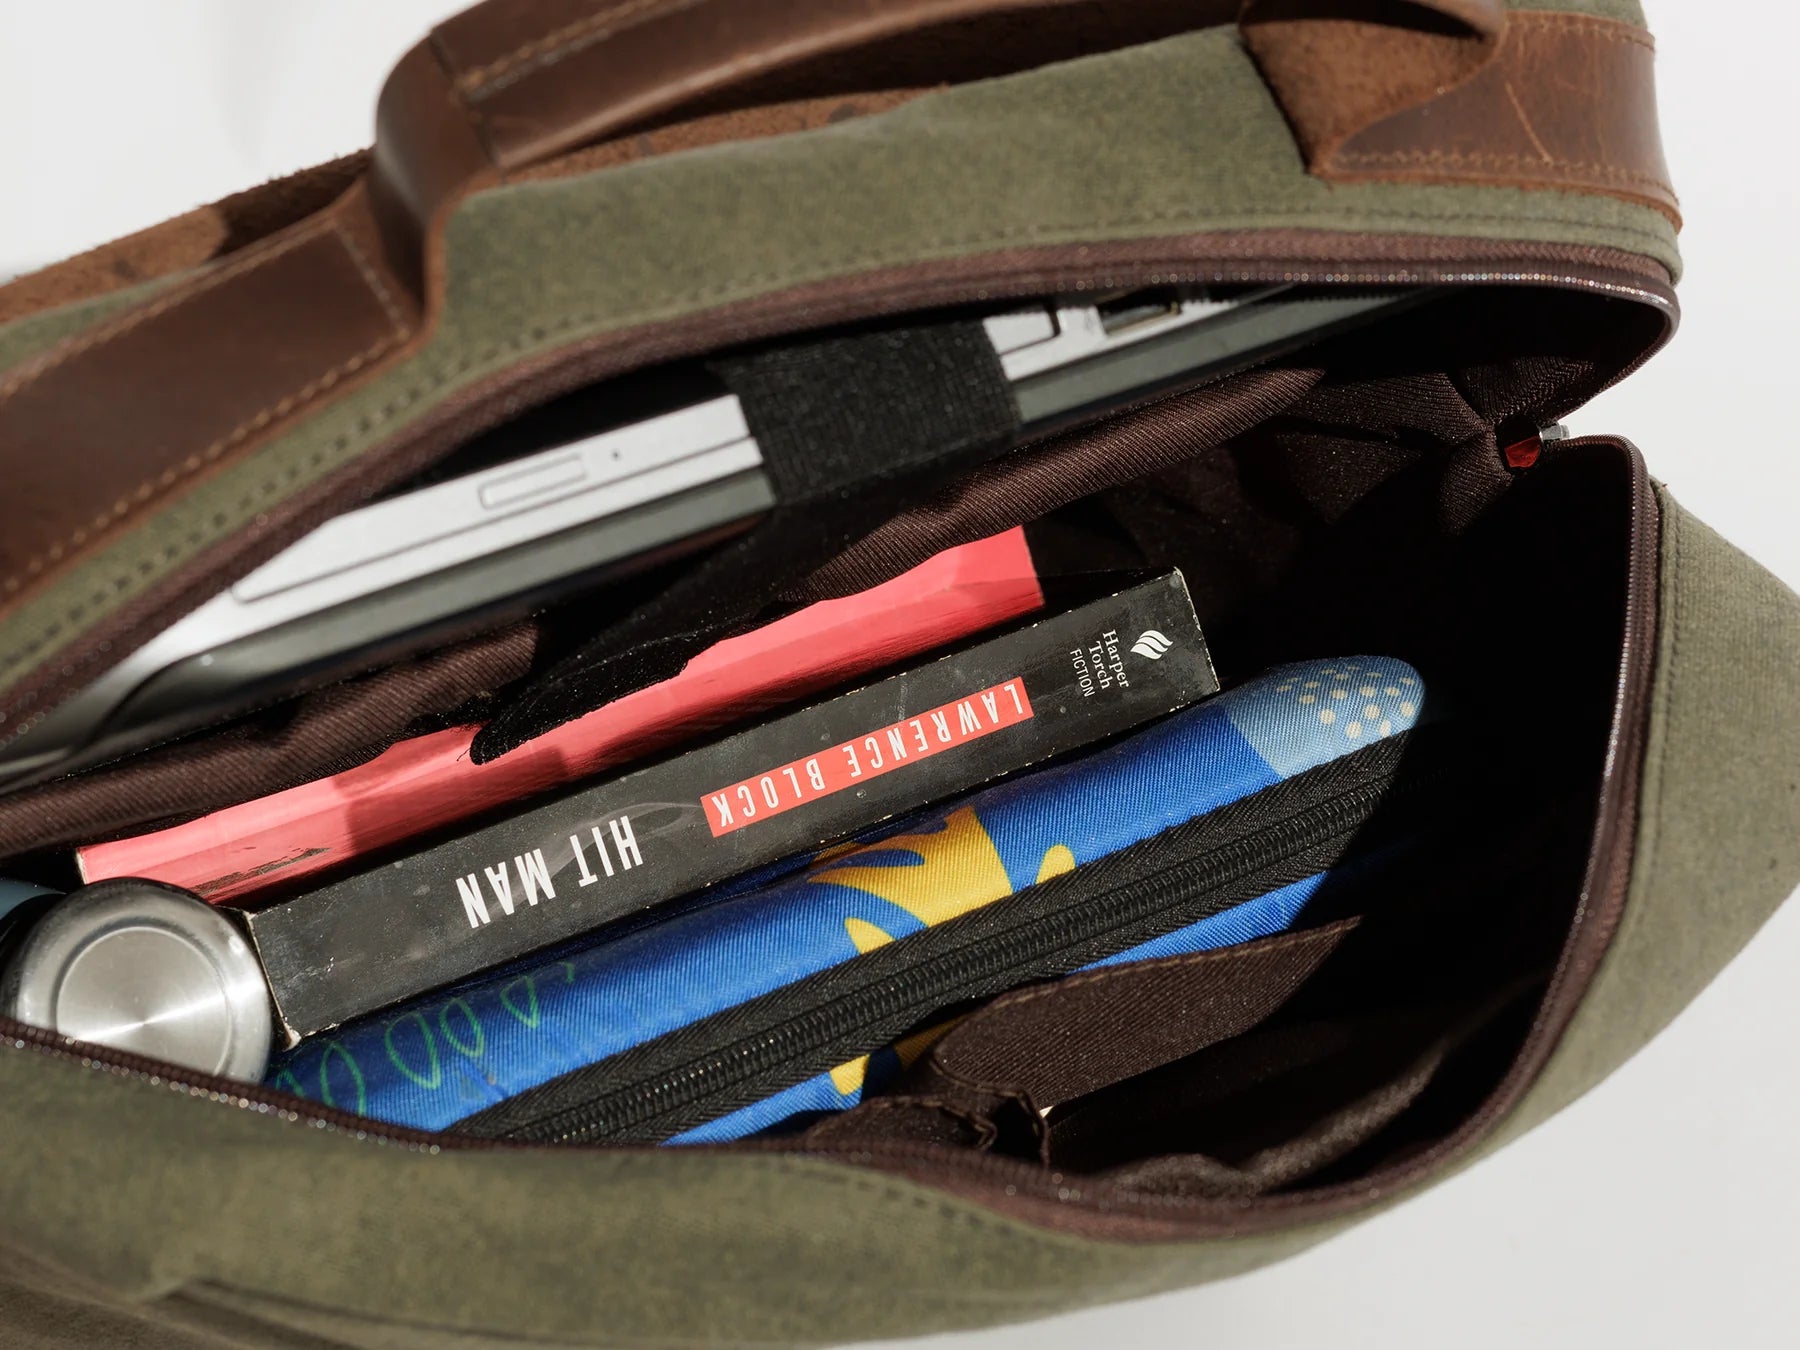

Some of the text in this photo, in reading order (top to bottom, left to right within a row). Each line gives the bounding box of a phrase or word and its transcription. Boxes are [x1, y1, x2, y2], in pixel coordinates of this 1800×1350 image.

[1070, 648, 1095, 697] FICTION
[1088, 641, 1113, 690] Torch
[1103, 629, 1129, 688] Harper
[711, 683, 1024, 827] LAWRENCE BLOCK
[456, 815, 644, 928] HIT MAN
